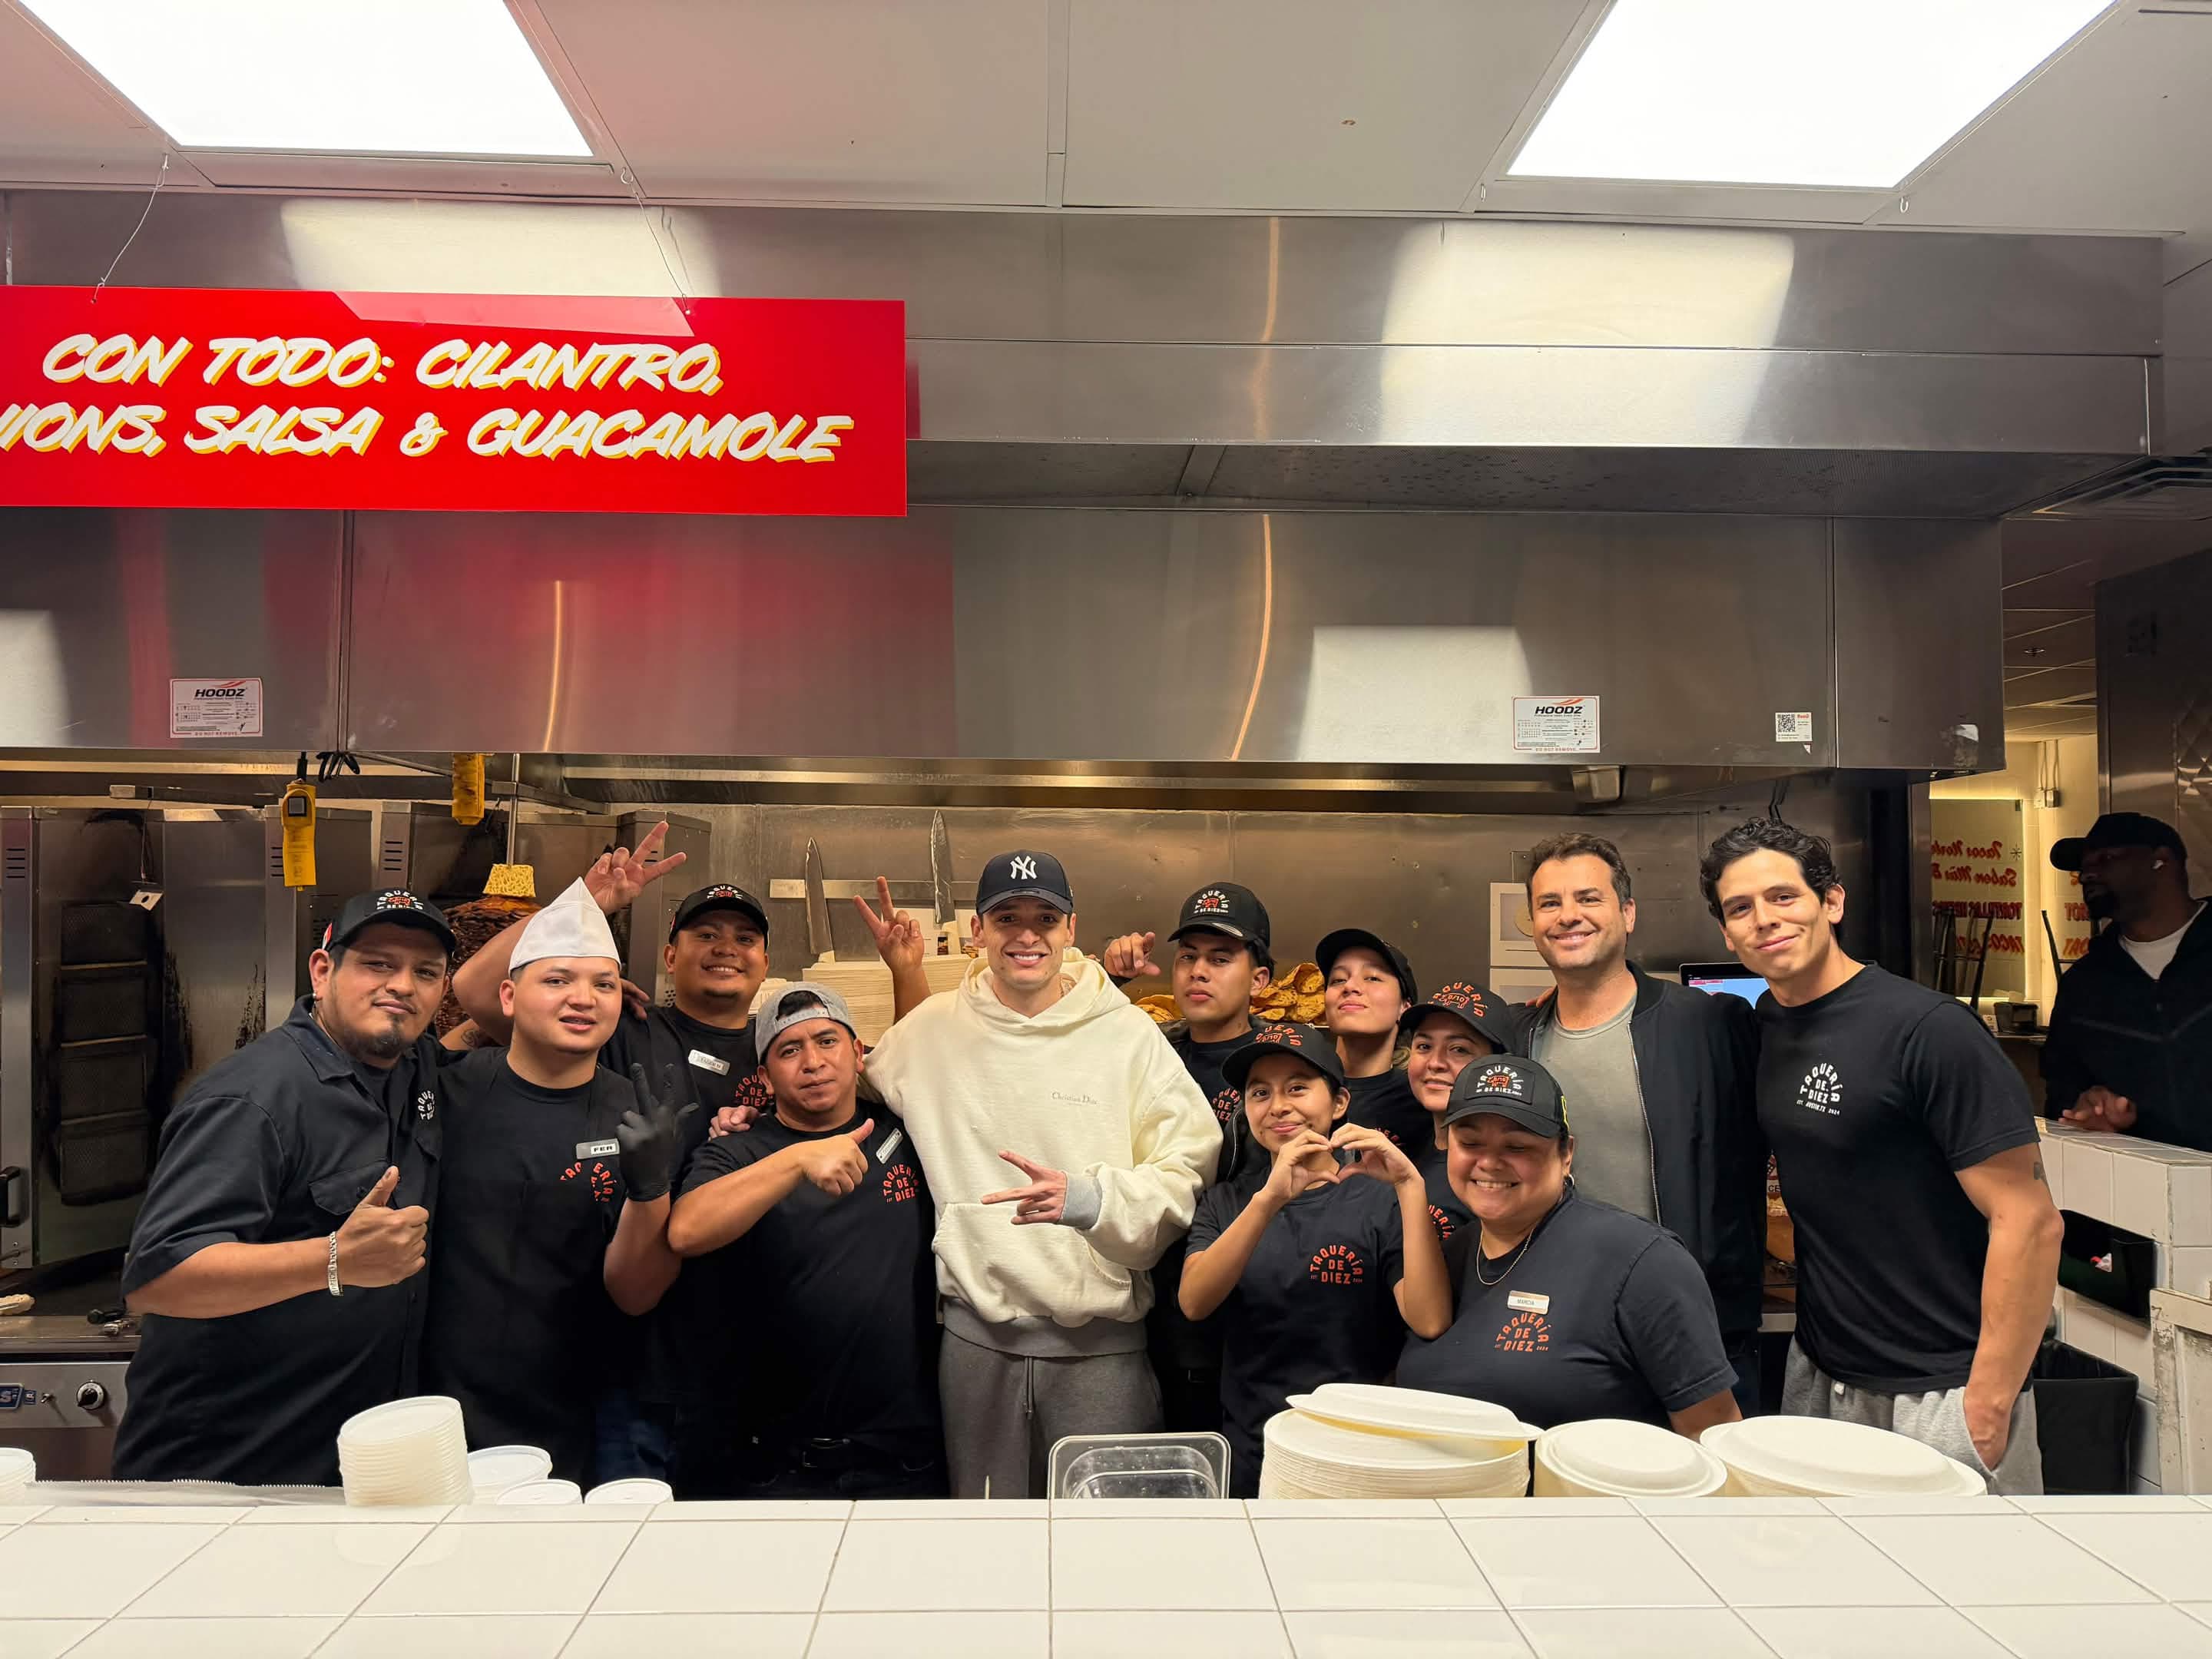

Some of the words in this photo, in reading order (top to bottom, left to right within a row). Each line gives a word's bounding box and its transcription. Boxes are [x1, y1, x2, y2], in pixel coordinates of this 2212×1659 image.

[43, 334, 194, 387] CON
[203, 336, 394, 387] TODO:
[416, 339, 724, 395] CILANTRO,
[184, 405, 384, 457] SALSA
[400, 412, 449, 456] &
[467, 411, 855, 464] GUACAMOLE
[195, 688, 245, 697] HOODZ
[1535, 706, 1583, 714] HOODZ
[1010, 856, 1037, 879] NY
[750, 1087, 763, 1097] DE
[1808, 1089, 1829, 1104] DIEZ
[1218, 1100, 1230, 1110] DE
[896, 1177, 909, 1189] DE
[895, 1187, 915, 1202] DIEZ
[1310, 1245, 1363, 1275] TAQUERÍA
[1328, 1260, 1344, 1270] DE
[1321, 1271, 1351, 1284] DIEZ
[1495, 1312, 1551, 1343] TAQUERÍA
[1514, 1328, 1532, 1339] DE
[1504, 1340, 1535, 1352] DIEZ
